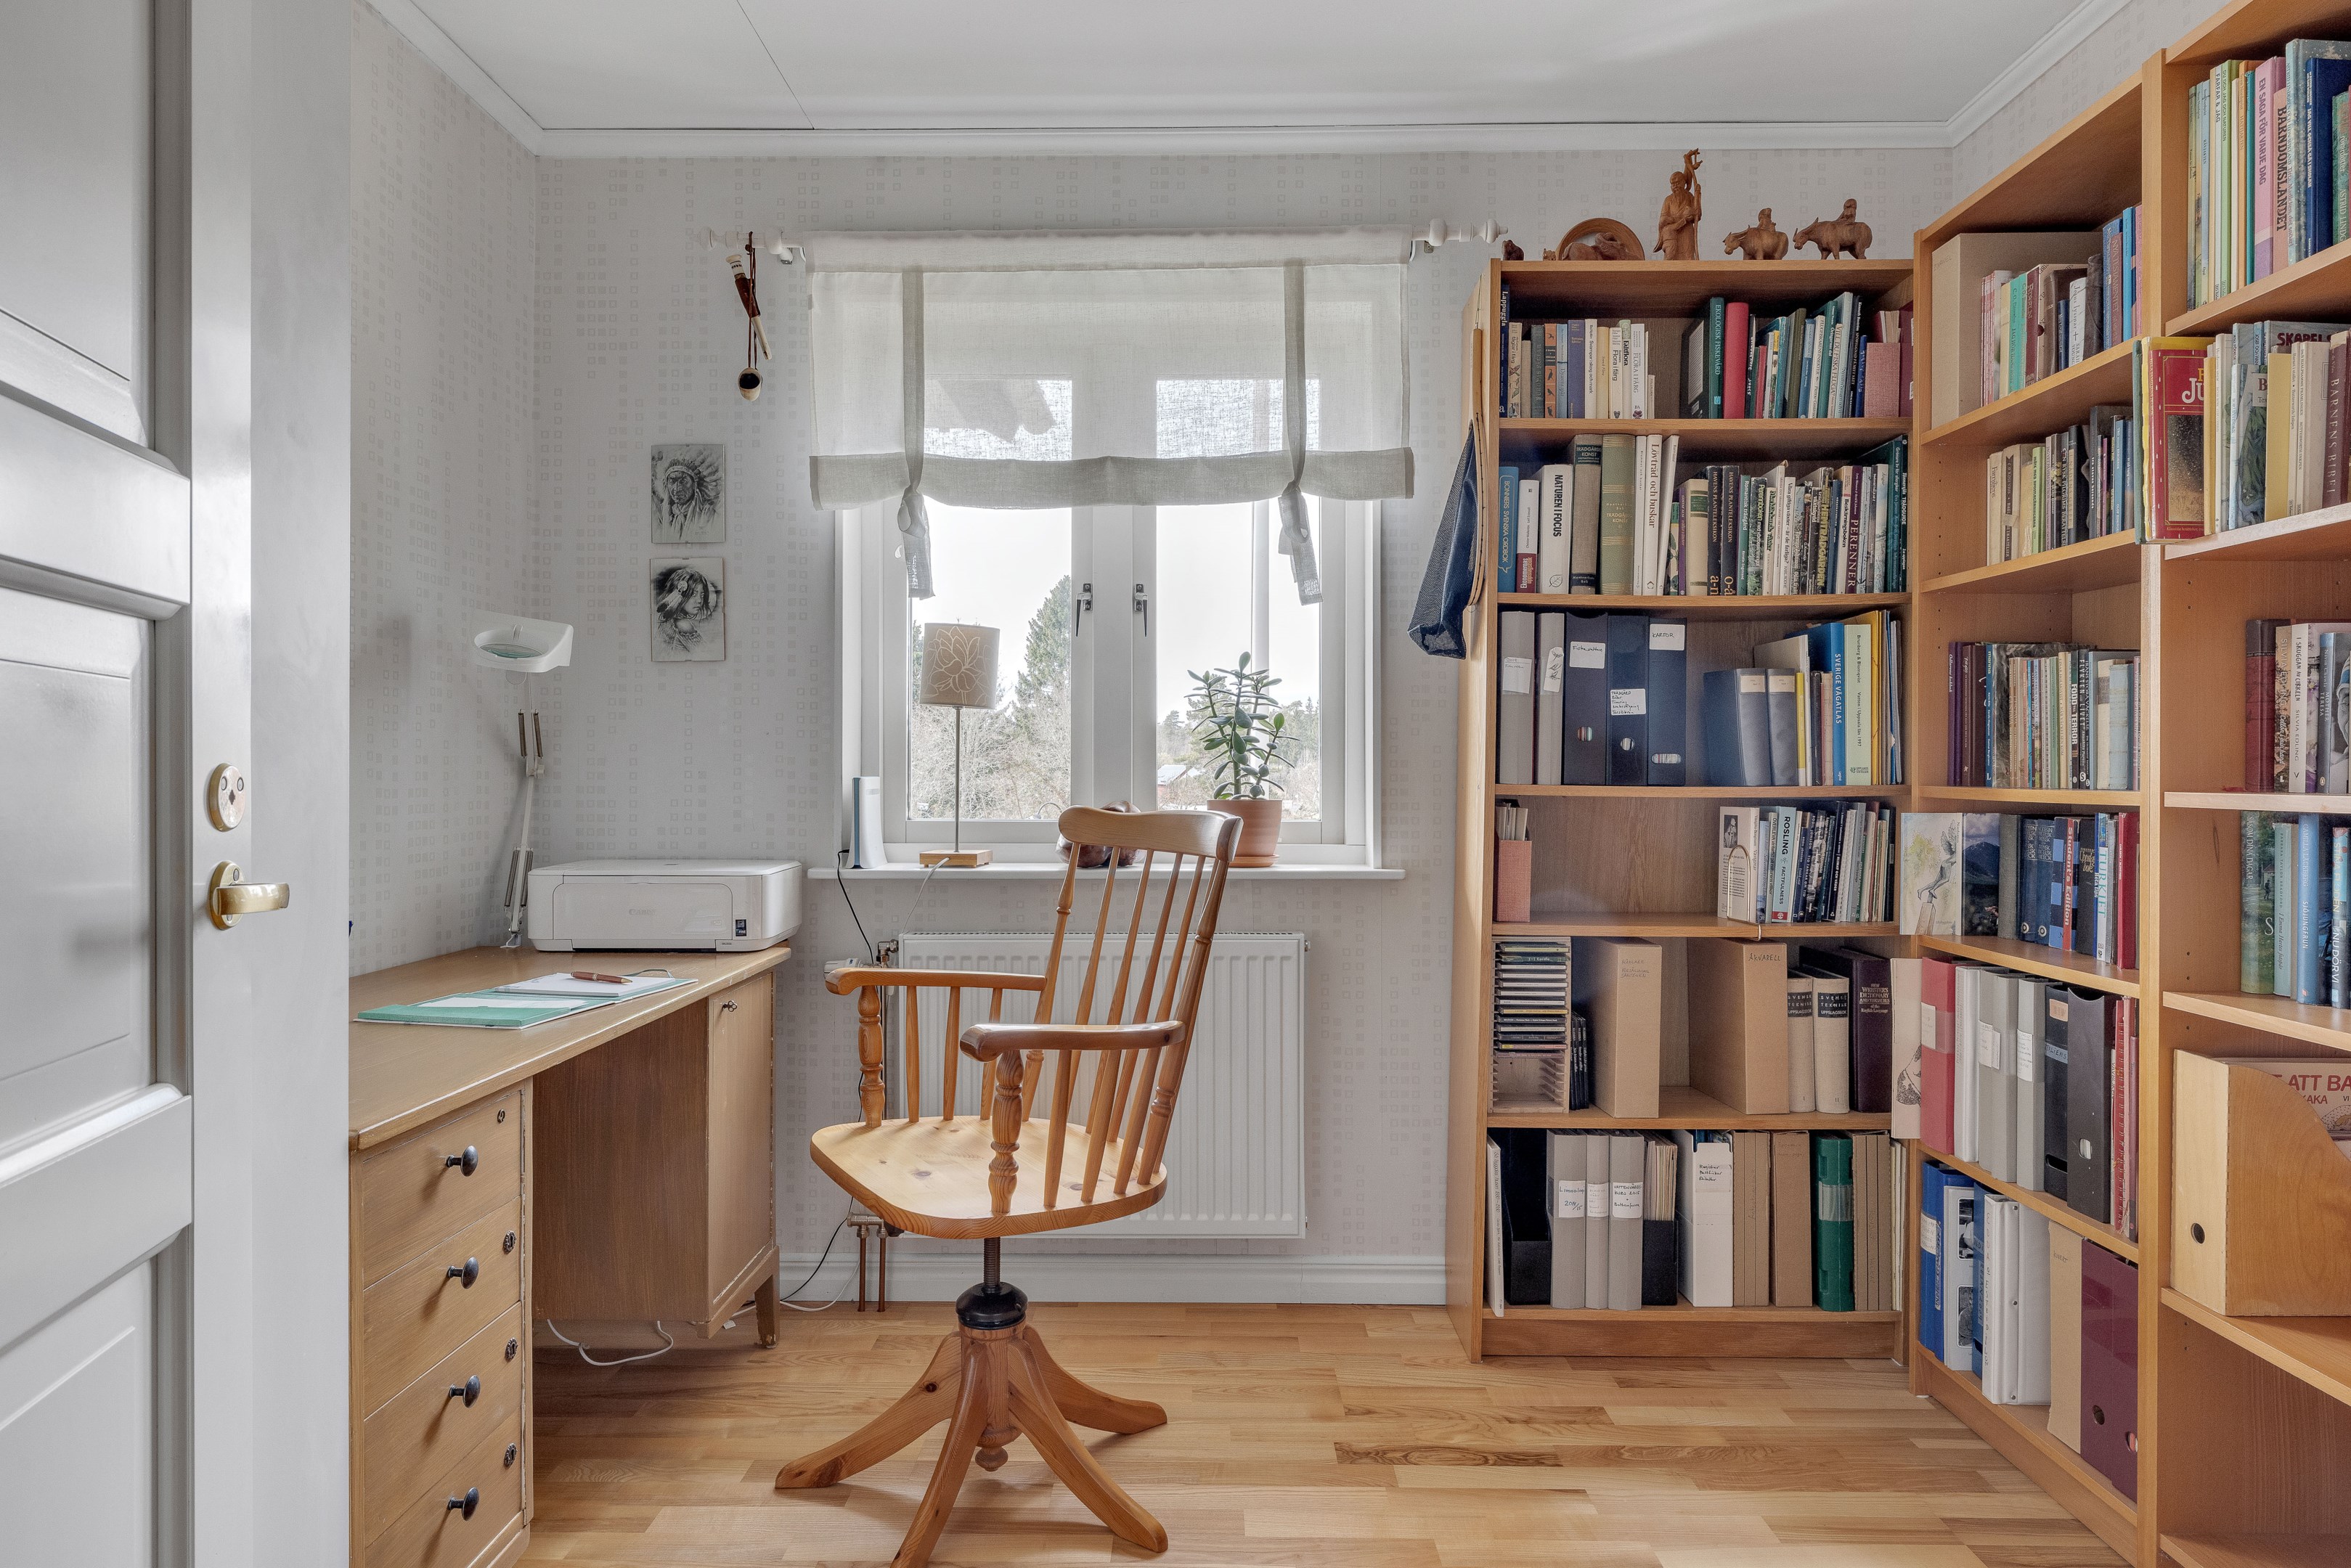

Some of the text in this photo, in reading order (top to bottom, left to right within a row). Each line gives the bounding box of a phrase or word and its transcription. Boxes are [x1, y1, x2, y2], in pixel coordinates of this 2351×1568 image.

[2259, 78, 2266, 91] EN
[2259, 119, 2268, 135] FÖR
[2276, 107, 2287, 232] BARNDOMSLANDET
[1834, 342, 1841, 351] DU
[2326, 379, 2339, 494] BARNENS BIBEL
[1650, 444, 1659, 478] Lövträd
[1553, 475, 1563, 537] NATUREN FOCUS
[1649, 499, 1658, 528] buskar
[1817, 504, 1828, 586] HEMTRÄDGÅRDEN
[1848, 520, 1859, 587] PERENNER
[1782, 817, 1790, 854] ROSLING
[2098, 850, 2107, 918] TURKIET
[2332, 932, 2340, 947] NU
[2332, 950, 2341, 971] DÖR
[2332, 973, 2339, 983] VI
[2288, 1074, 2322, 1091] ATT
